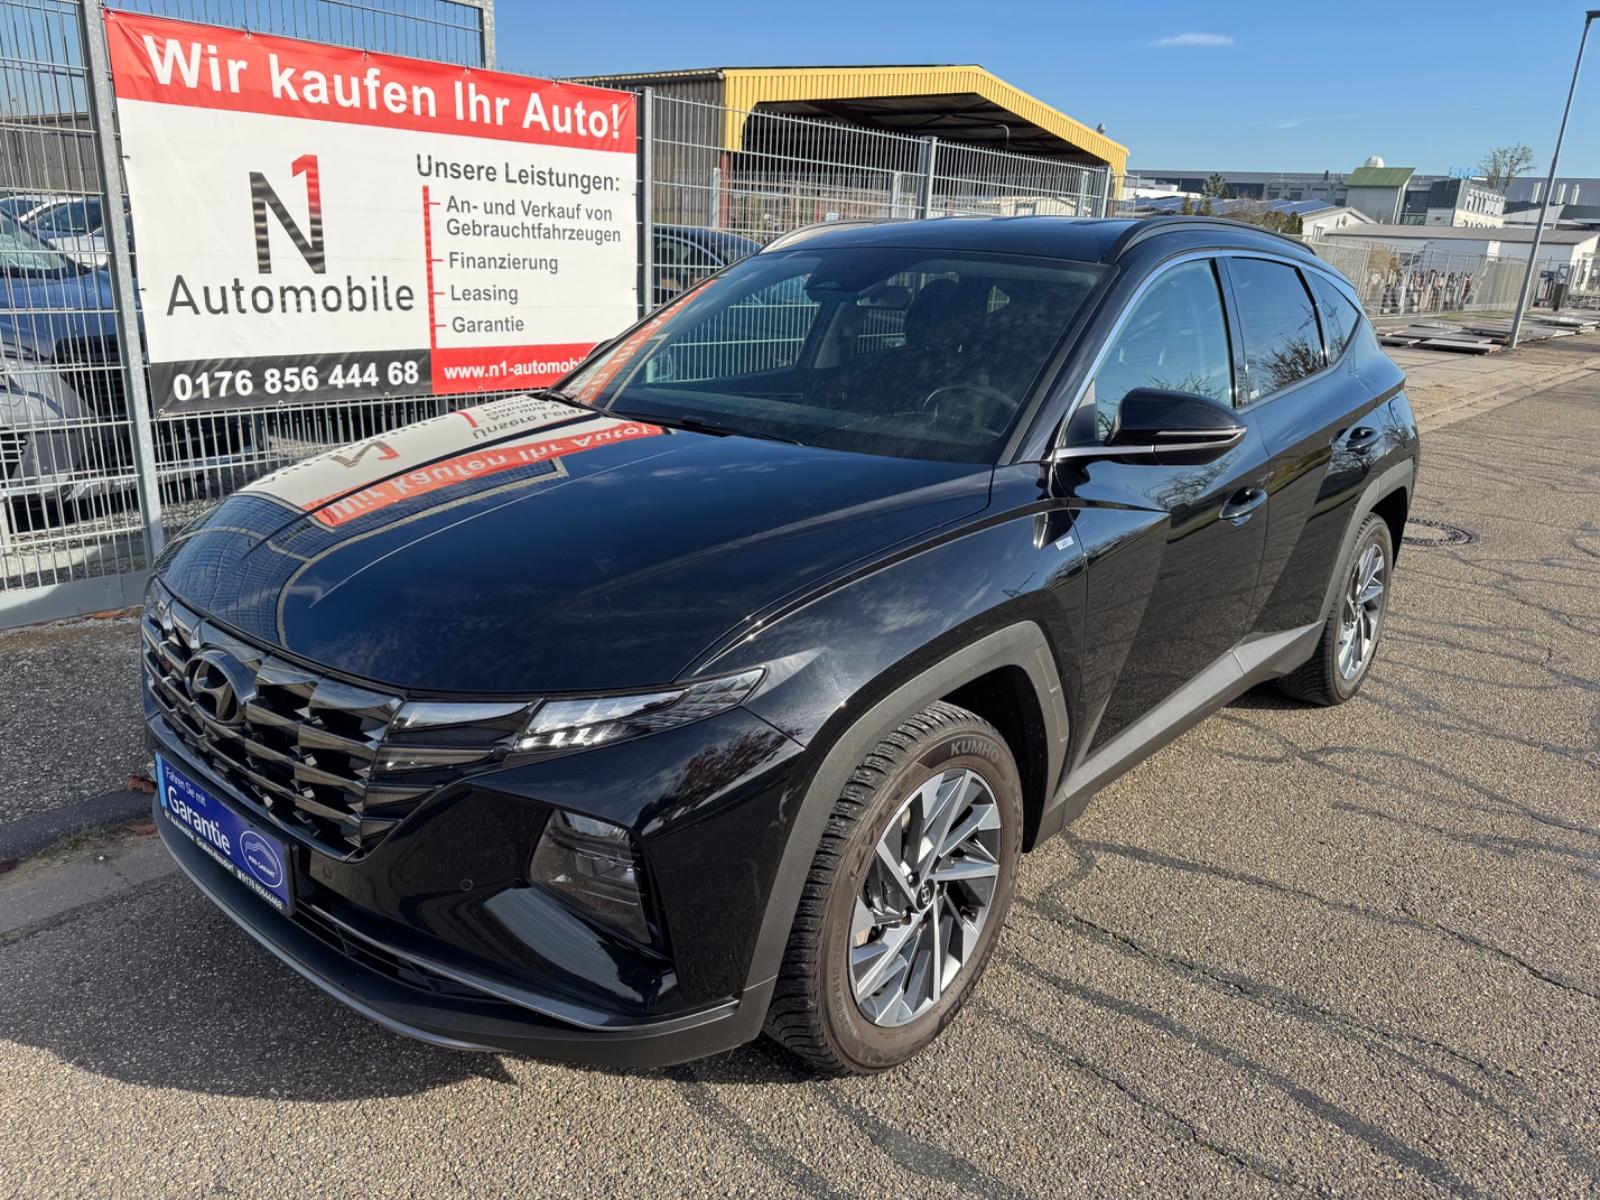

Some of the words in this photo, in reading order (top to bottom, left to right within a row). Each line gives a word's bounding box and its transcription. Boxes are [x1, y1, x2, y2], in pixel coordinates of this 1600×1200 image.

[143, 34, 248, 94] Wir
[268, 54, 437, 117] kaufen
[454, 80, 510, 126] Ihr
[522, 92, 620, 139] Auto!
[416, 153, 497, 182] Unsere
[505, 162, 620, 194] Leistungen:
[447, 195, 478, 214] An-
[483, 199, 515, 216] und
[520, 200, 581, 220] Verkauf
[585, 208, 613, 221] von
[446, 218, 621, 245] Gebrauchtfahrzeugen
[448, 251, 558, 275] Finanzierung
[166, 274, 415, 316] Automobile
[450, 284, 519, 305] Leasing
[452, 315, 524, 333] Garantie
[173, 369, 254, 401] 0176
[263, 365, 319, 394] 856
[328, 362, 379, 389] 444
[387, 360, 419, 386] 68
[950, 739, 999, 762] KUMHO
[167, 785, 231, 856] Garantie
